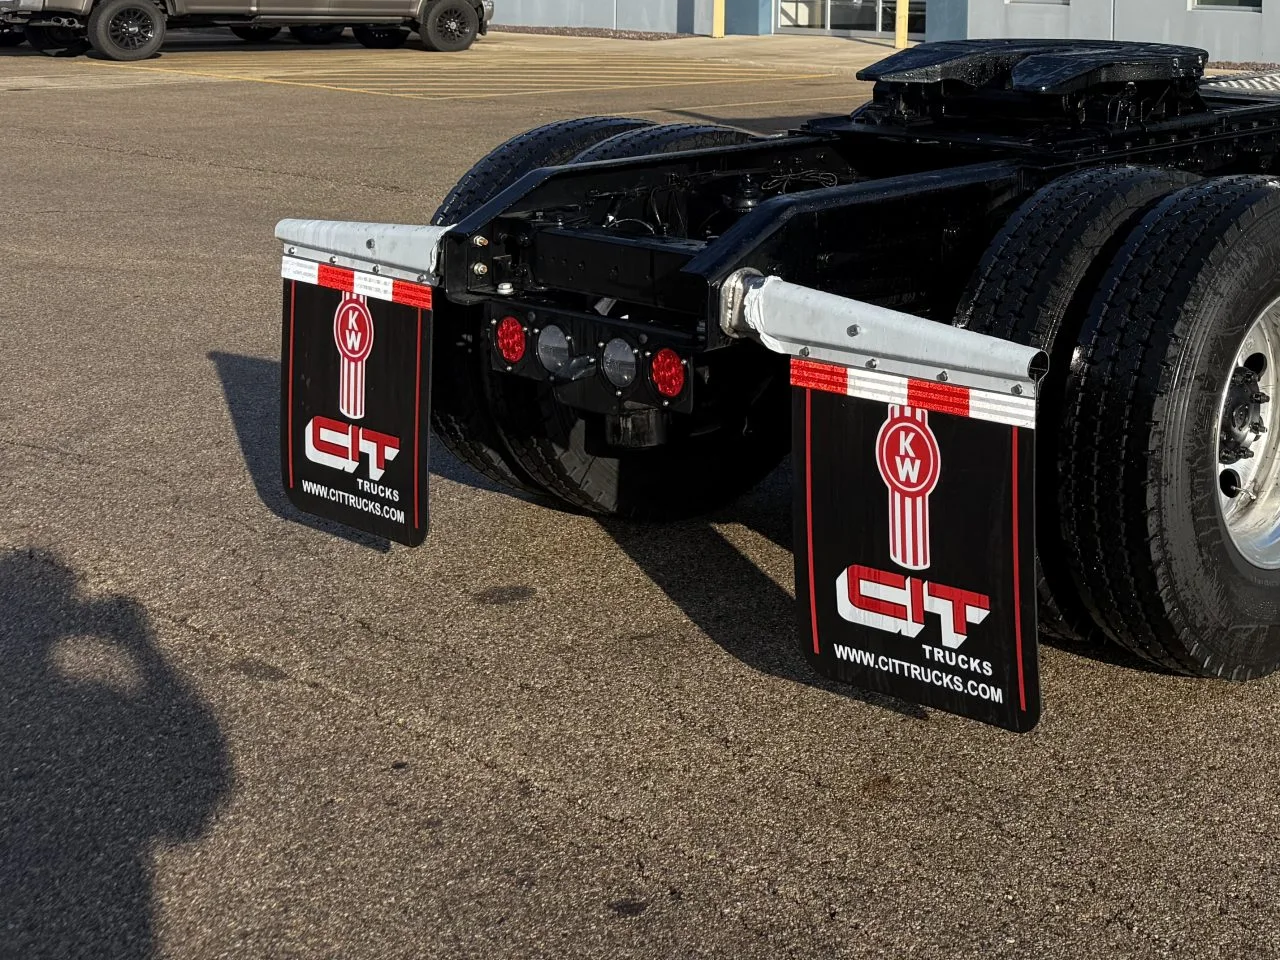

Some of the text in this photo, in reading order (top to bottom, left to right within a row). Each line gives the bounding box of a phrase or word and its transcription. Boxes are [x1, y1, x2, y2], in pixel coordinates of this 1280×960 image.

[305, 416, 400, 481] CIT
[302, 479, 405, 524] WWW.CITTRUCKS.COM
[356, 478, 400, 502] TRUCKS
[836, 564, 991, 649] CIT
[833, 643, 1003, 704] WWW.CITTRUCKS.COM
[922, 644, 993, 676] TRUCKS
